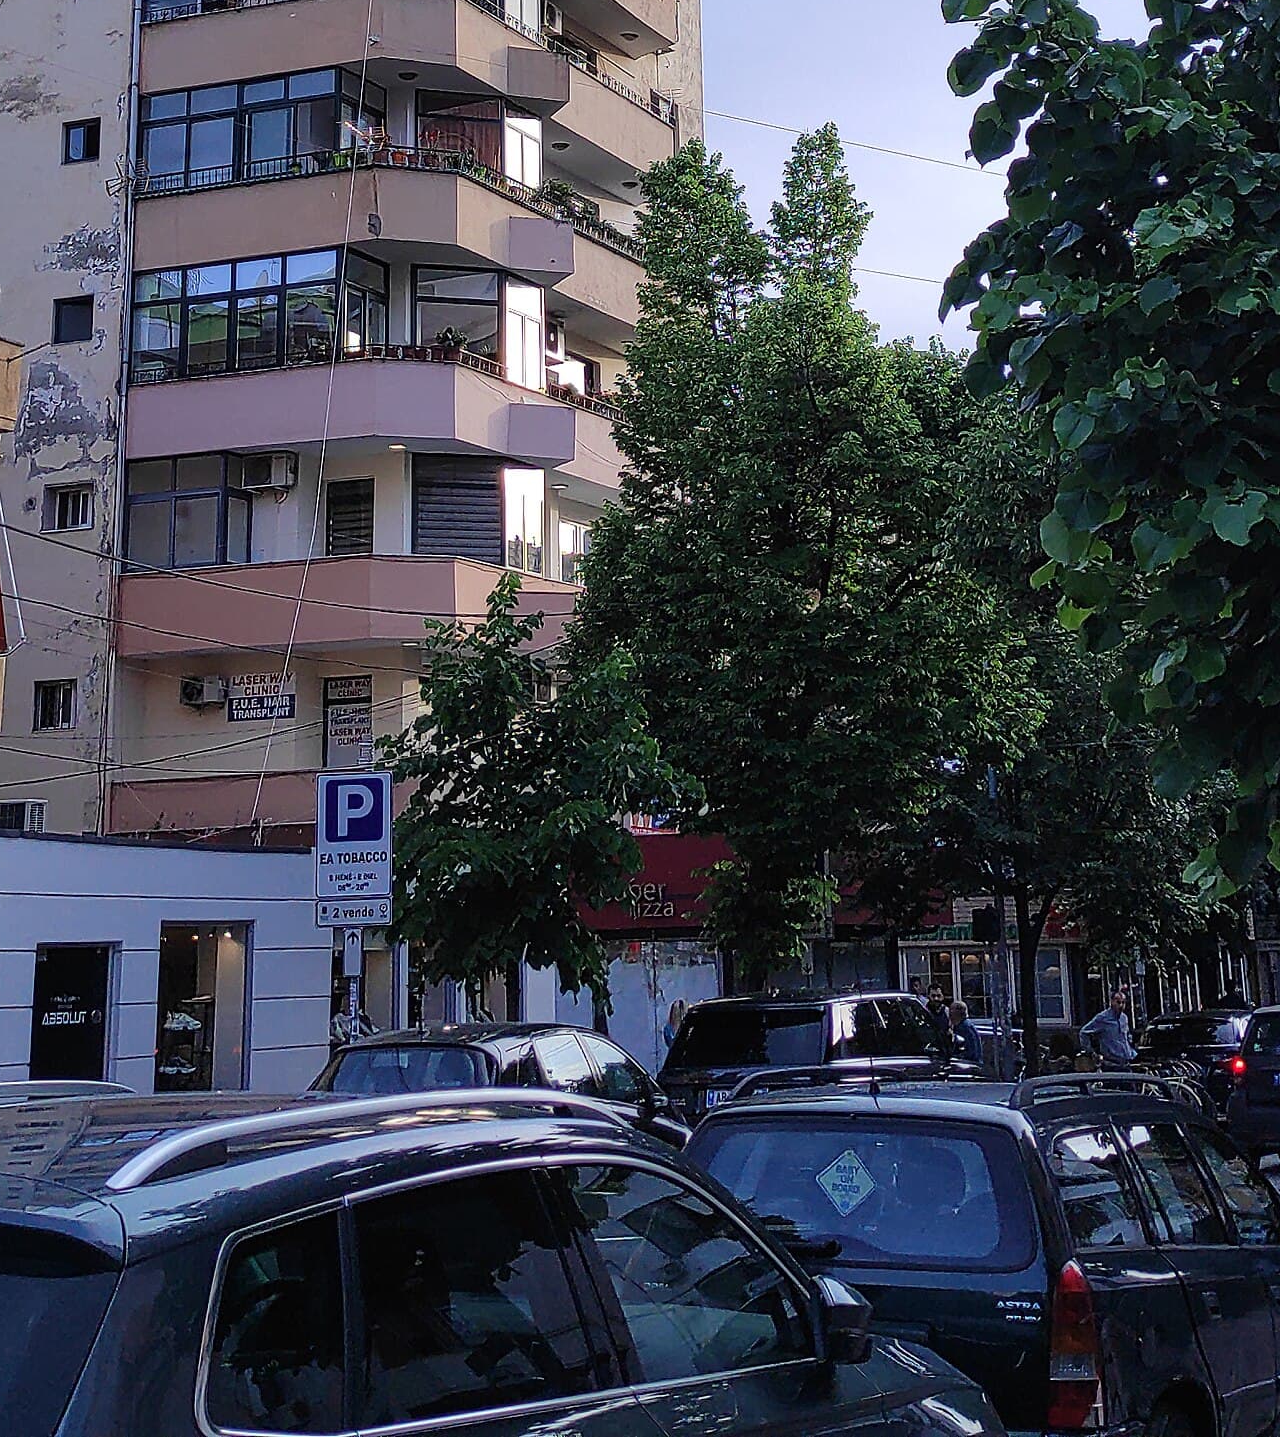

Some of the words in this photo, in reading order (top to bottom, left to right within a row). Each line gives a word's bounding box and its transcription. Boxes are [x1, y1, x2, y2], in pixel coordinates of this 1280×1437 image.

[232, 675, 267, 687] LASER
[232, 707, 291, 720] TRANSPLANT
[337, 784, 374, 837] P
[320, 853, 334, 865] EA
[337, 851, 388, 864] TOBACCO
[332, 907, 340, 919] 2
[42, 1011, 87, 1025] ABSOLUT
[996, 1300, 1041, 1310] ASTRA
